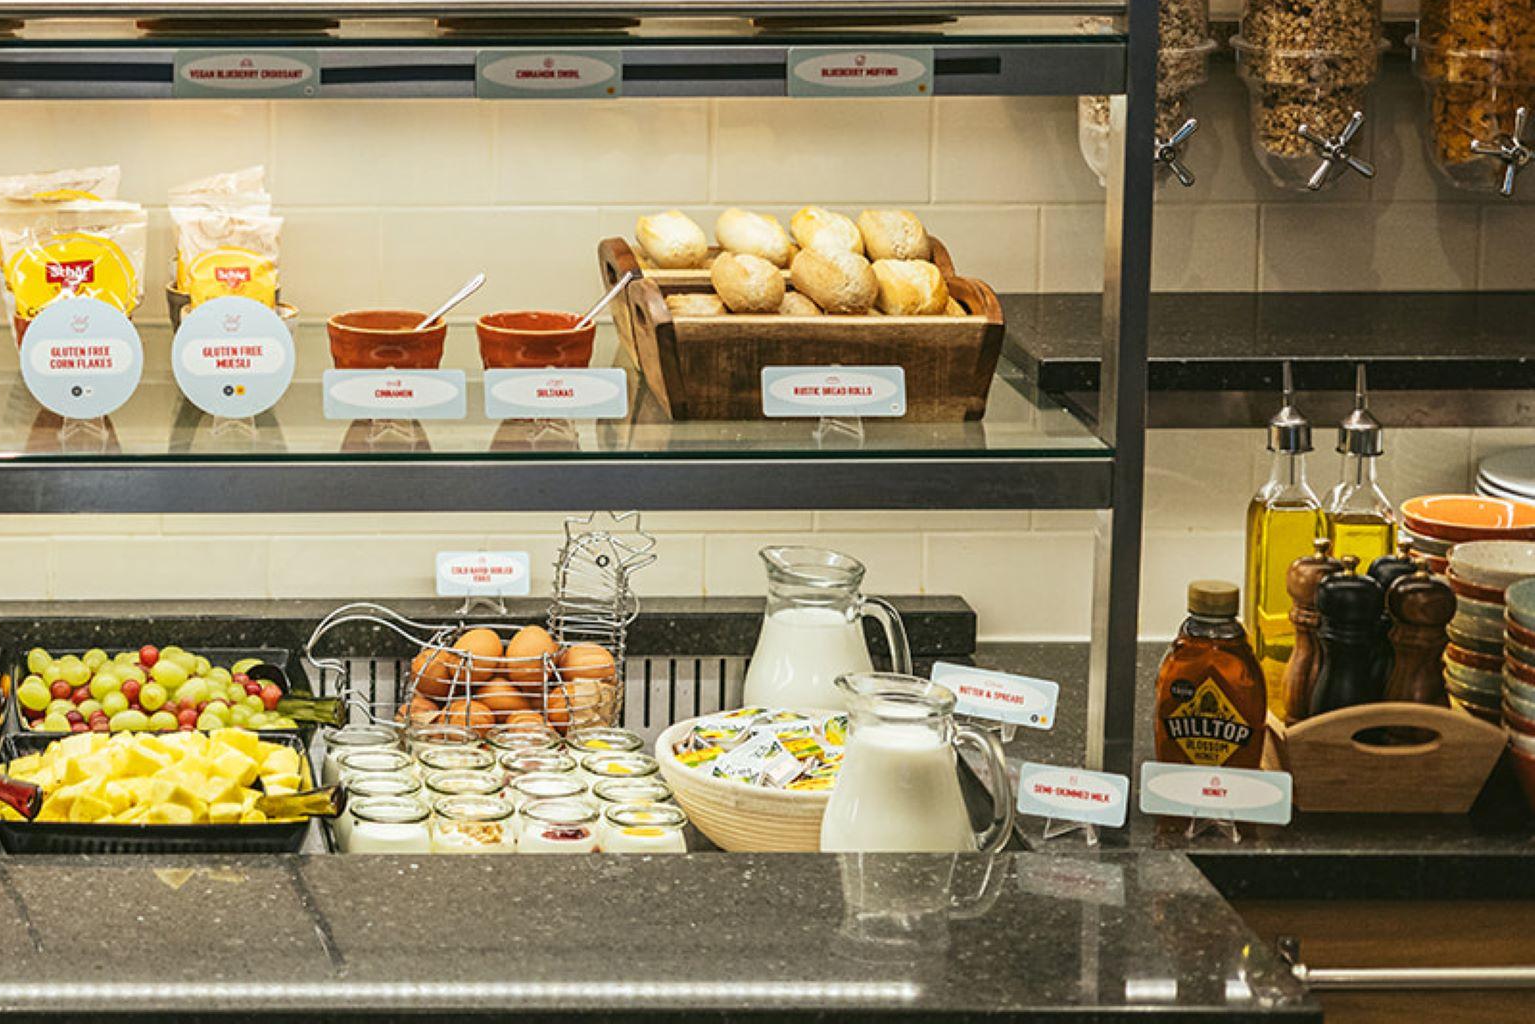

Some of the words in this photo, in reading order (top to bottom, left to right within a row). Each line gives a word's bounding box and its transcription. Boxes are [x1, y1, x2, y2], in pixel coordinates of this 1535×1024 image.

[50, 346, 86, 357] GLUTEN
[88, 345, 110, 356] FREE
[202, 346, 238, 357] GLUTEN
[240, 345, 263, 356] FREE
[50, 358, 75, 369] CORN
[77, 358, 113, 369] FLAKES
[216, 358, 251, 369] MUESLI
[374, 388, 414, 398] CINNAMON
[536, 388, 574, 398] SULTANAS
[1168, 717, 1250, 743] HILLTOP
[1185, 739, 1230, 753] BLOSSOM
[1202, 787, 1228, 797] HONEY
